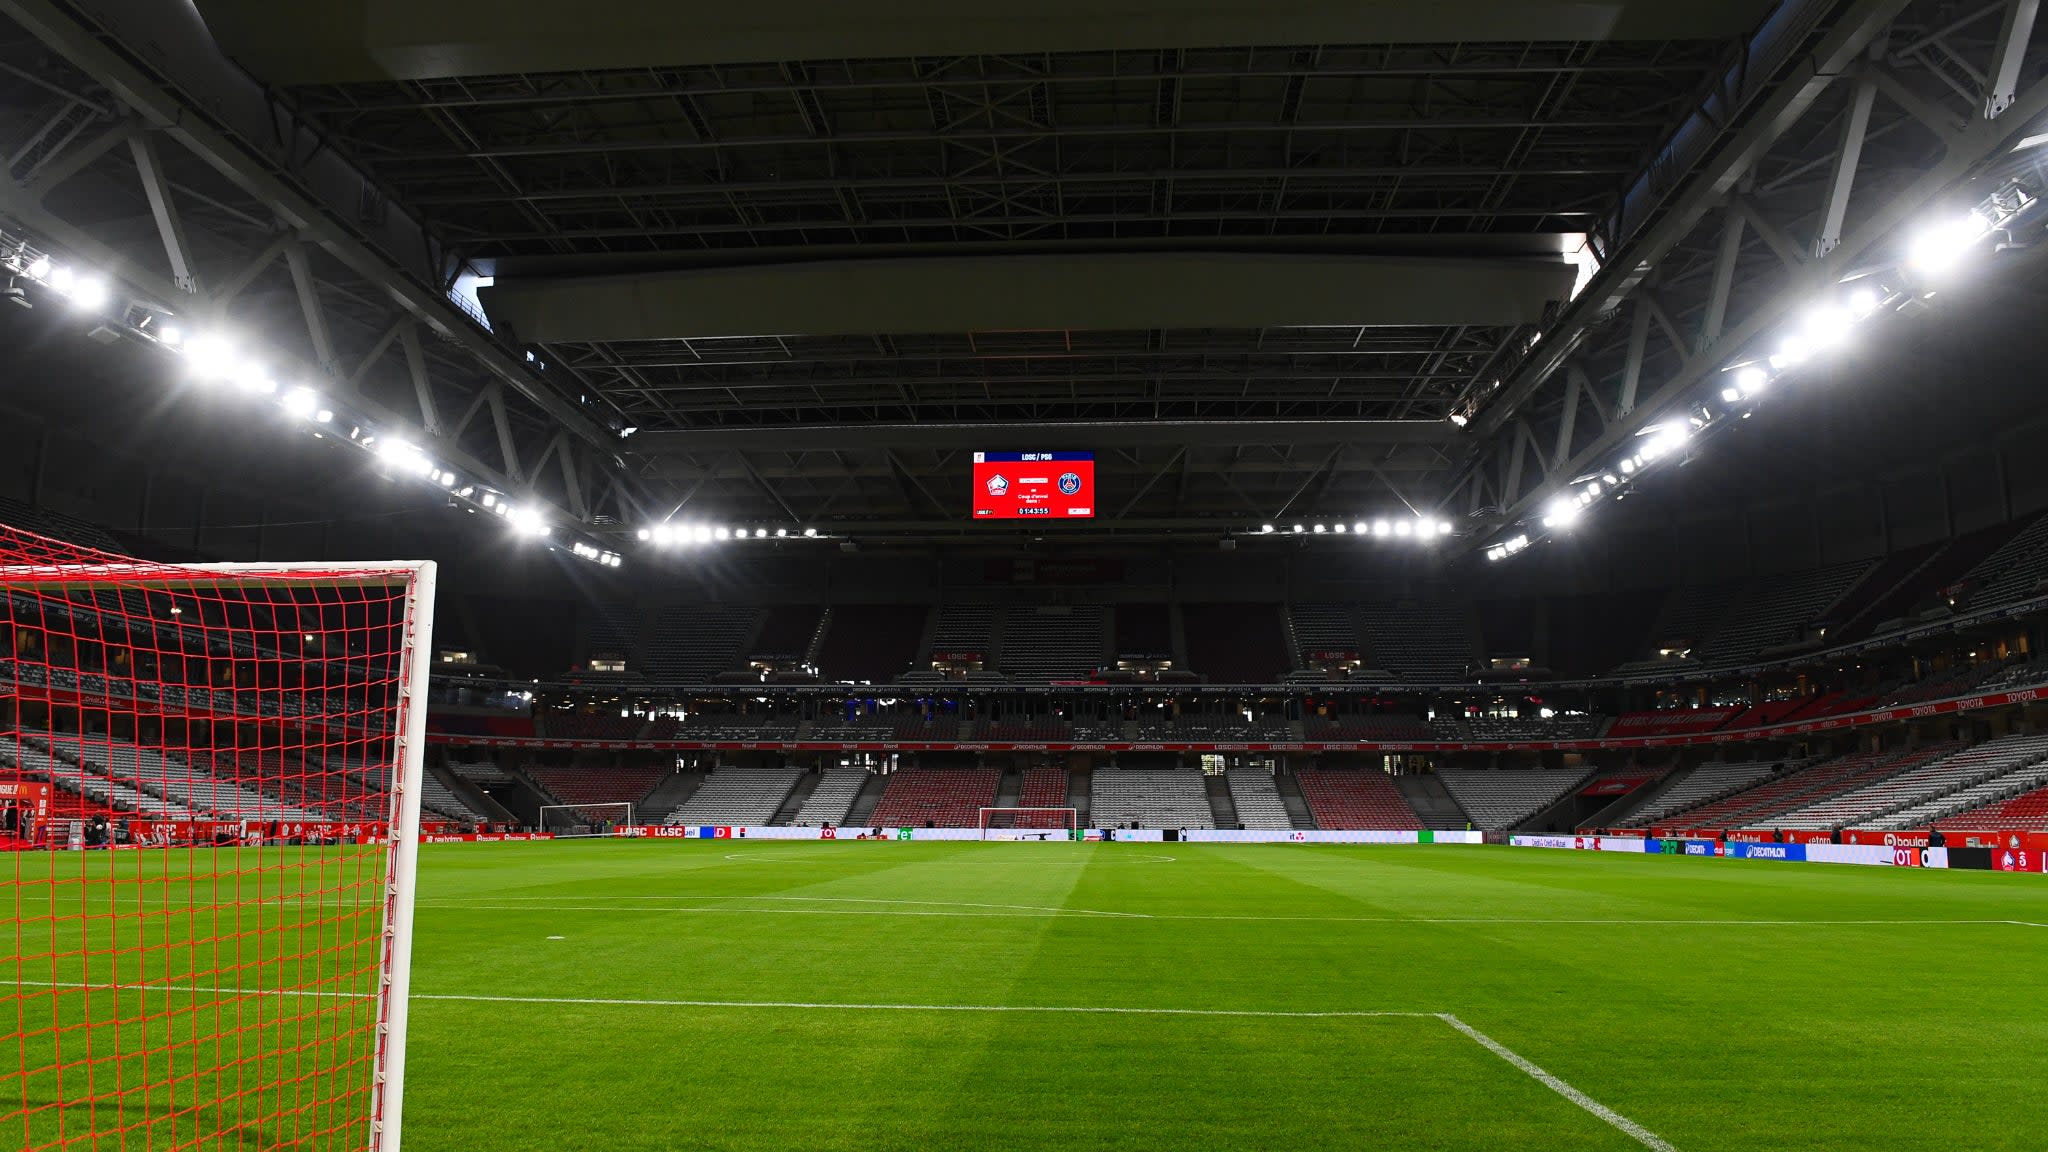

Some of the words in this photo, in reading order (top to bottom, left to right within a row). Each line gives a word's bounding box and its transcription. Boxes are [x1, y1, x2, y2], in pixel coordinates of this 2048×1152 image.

[2006, 690, 2038, 703] TOYOTA
[1957, 698, 1984, 710] TOYOTA
[1912, 705, 1937, 717] TOYOTA
[1871, 712, 1893, 722] TOYOTA
[620, 827, 647, 836] LOSC
[655, 828, 682, 836] LOSC
[1753, 847, 1786, 858] DECATHLON
